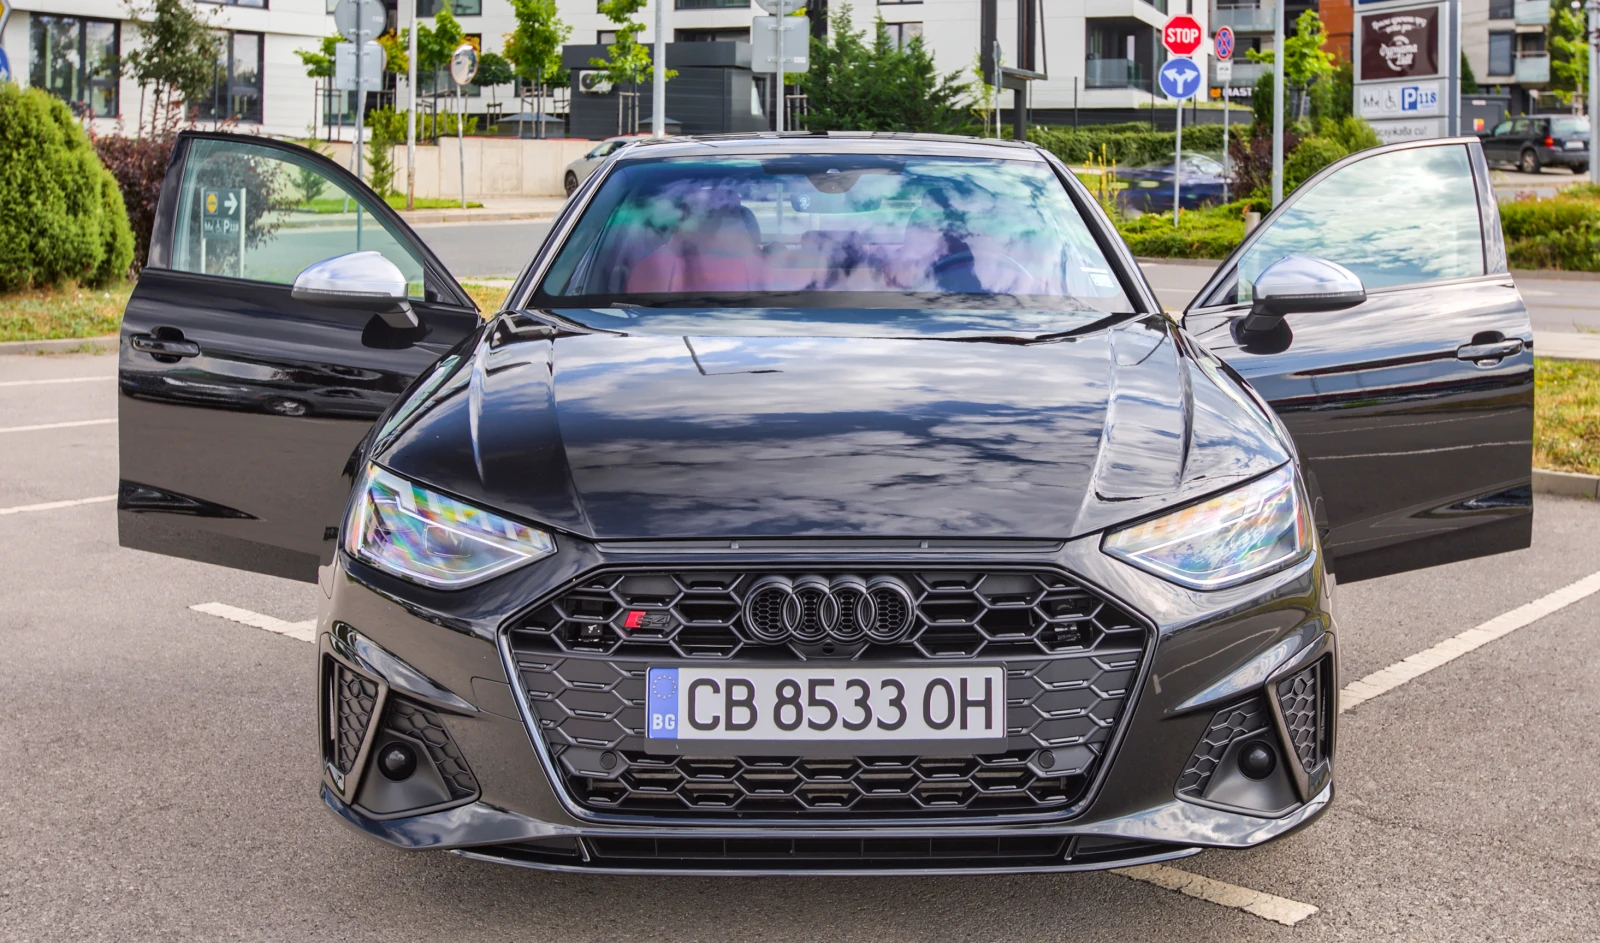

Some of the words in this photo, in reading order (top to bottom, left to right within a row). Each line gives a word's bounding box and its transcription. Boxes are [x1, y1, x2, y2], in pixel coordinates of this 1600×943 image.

[1166, 27, 1199, 44] STOP
[1222, 87, 1259, 97] MAST
[1403, 88, 1417, 110] P
[1419, 92, 1437, 104] 118
[687, 678, 758, 731] CB
[773, 678, 907, 731] 8533
[922, 677, 993, 730] OH
[652, 713, 676, 730] BG
